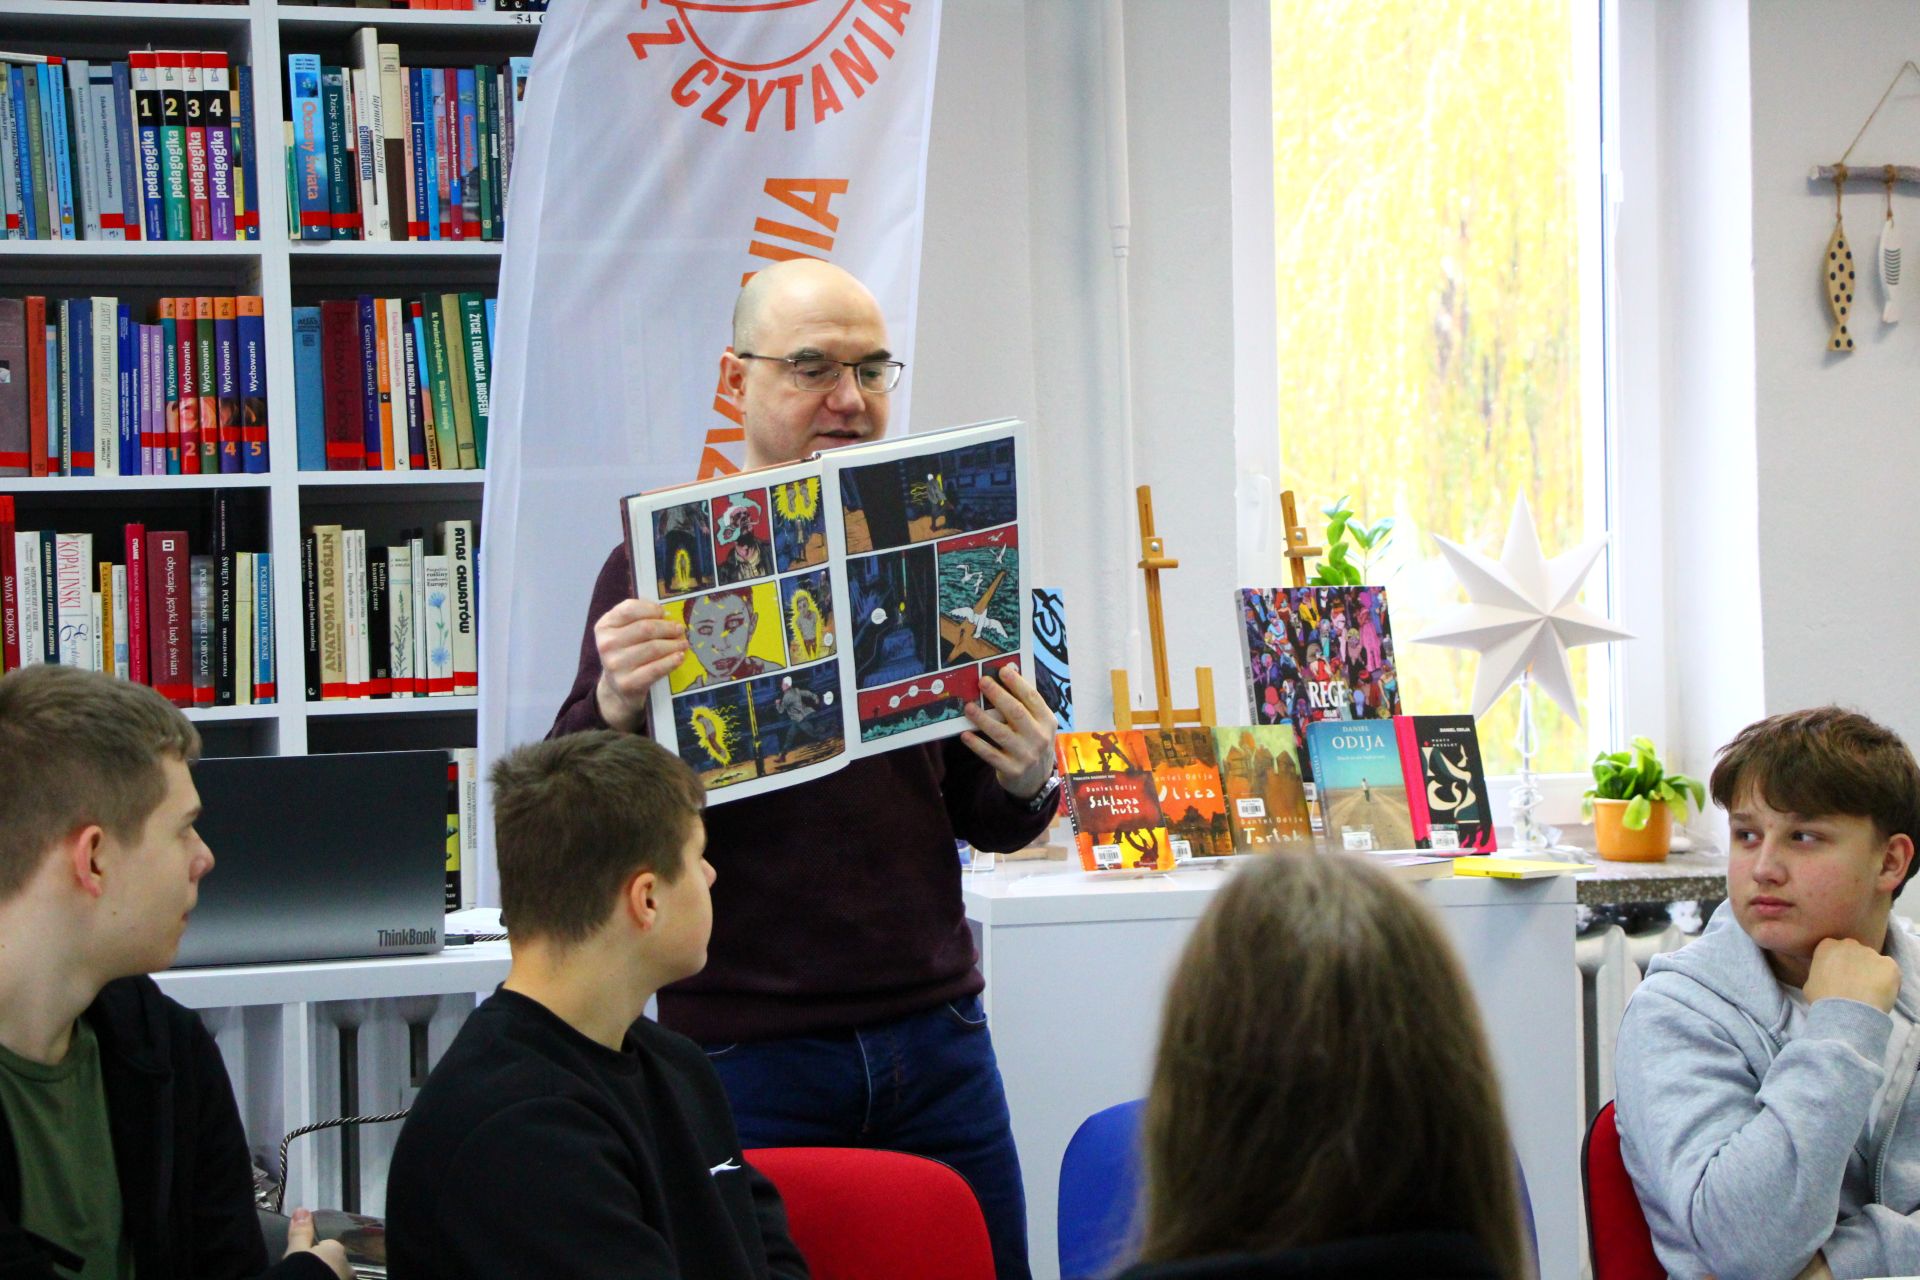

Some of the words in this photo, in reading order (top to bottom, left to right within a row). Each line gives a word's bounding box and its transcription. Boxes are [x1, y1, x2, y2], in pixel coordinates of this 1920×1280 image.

[516, 13, 532, 24] 54
[669, 0, 912, 133] CZYTANIA
[140, 98, 152, 117] 1
[165, 97, 178, 117] 2
[188, 99, 201, 118] 3
[209, 99, 223, 117] 4
[329, 93, 338, 119] Dzieje
[300, 101, 317, 153] Oceany
[331, 121, 341, 142] życia
[142, 131, 161, 199] pedagogika
[166, 130, 185, 198] pedagogika
[210, 130, 229, 199] pedagogika
[332, 145, 340, 155] na
[359, 125, 372, 181] GEOMORFOLOGIA
[189, 131, 207, 200] pedagogika
[305, 155, 320, 200] świata
[334, 157, 343, 182] Ziemi
[469, 313, 481, 335] ŻYCIE
[364, 324, 373, 359] Genetyka
[405, 333, 413, 363] BIOLOGIA
[167, 344, 176, 397] Wychowanie
[183, 341, 192, 393] Wychowanie
[202, 340, 211, 393] Wychowanie
[222, 341, 232, 393] Wychowanie
[249, 341, 258, 392] Wychowanie
[472, 340, 486, 382] EWOLUCJA
[366, 360, 374, 396] człowieka
[407, 363, 416, 396] ROZWOJU
[475, 382, 489, 417] BIOSFERY
[169, 447, 177, 461] 1
[184, 442, 196, 456] 2
[204, 442, 216, 456] 3
[225, 442, 236, 456] 4
[250, 442, 262, 456] 5
[454, 528, 466, 561] ATLAS
[57, 541, 81, 609] KOPALIŃSKI
[166, 556, 177, 595] obyczaje,
[221, 556, 229, 586] ŚWIĘTA
[321, 533, 335, 588] ROŚLIN
[5, 575, 13, 604] ŚWIAT
[371, 562, 379, 612] kosmetyczne
[378, 562, 386, 591] Rośliny
[166, 597, 178, 624] języki,
[456, 565, 471, 634] CHWASTÓW
[6, 608, 15, 645] BOJKÓW
[168, 626, 179, 645] ludy
[323, 591, 337, 672] ANATOMIA
[170, 647, 179, 676] świata
[200, 640, 208, 676] OBYCZAJE
[1332, 736, 1385, 752] ODIJA
[1342, 725, 1369, 733] DANIEL
[1154, 774, 1181, 782] aniel
[1089, 795, 1139, 809] Szklana
[1111, 805, 1140, 815] huta
[1243, 828, 1304, 845] Tartak
[377, 927, 437, 948] ThinkBook
